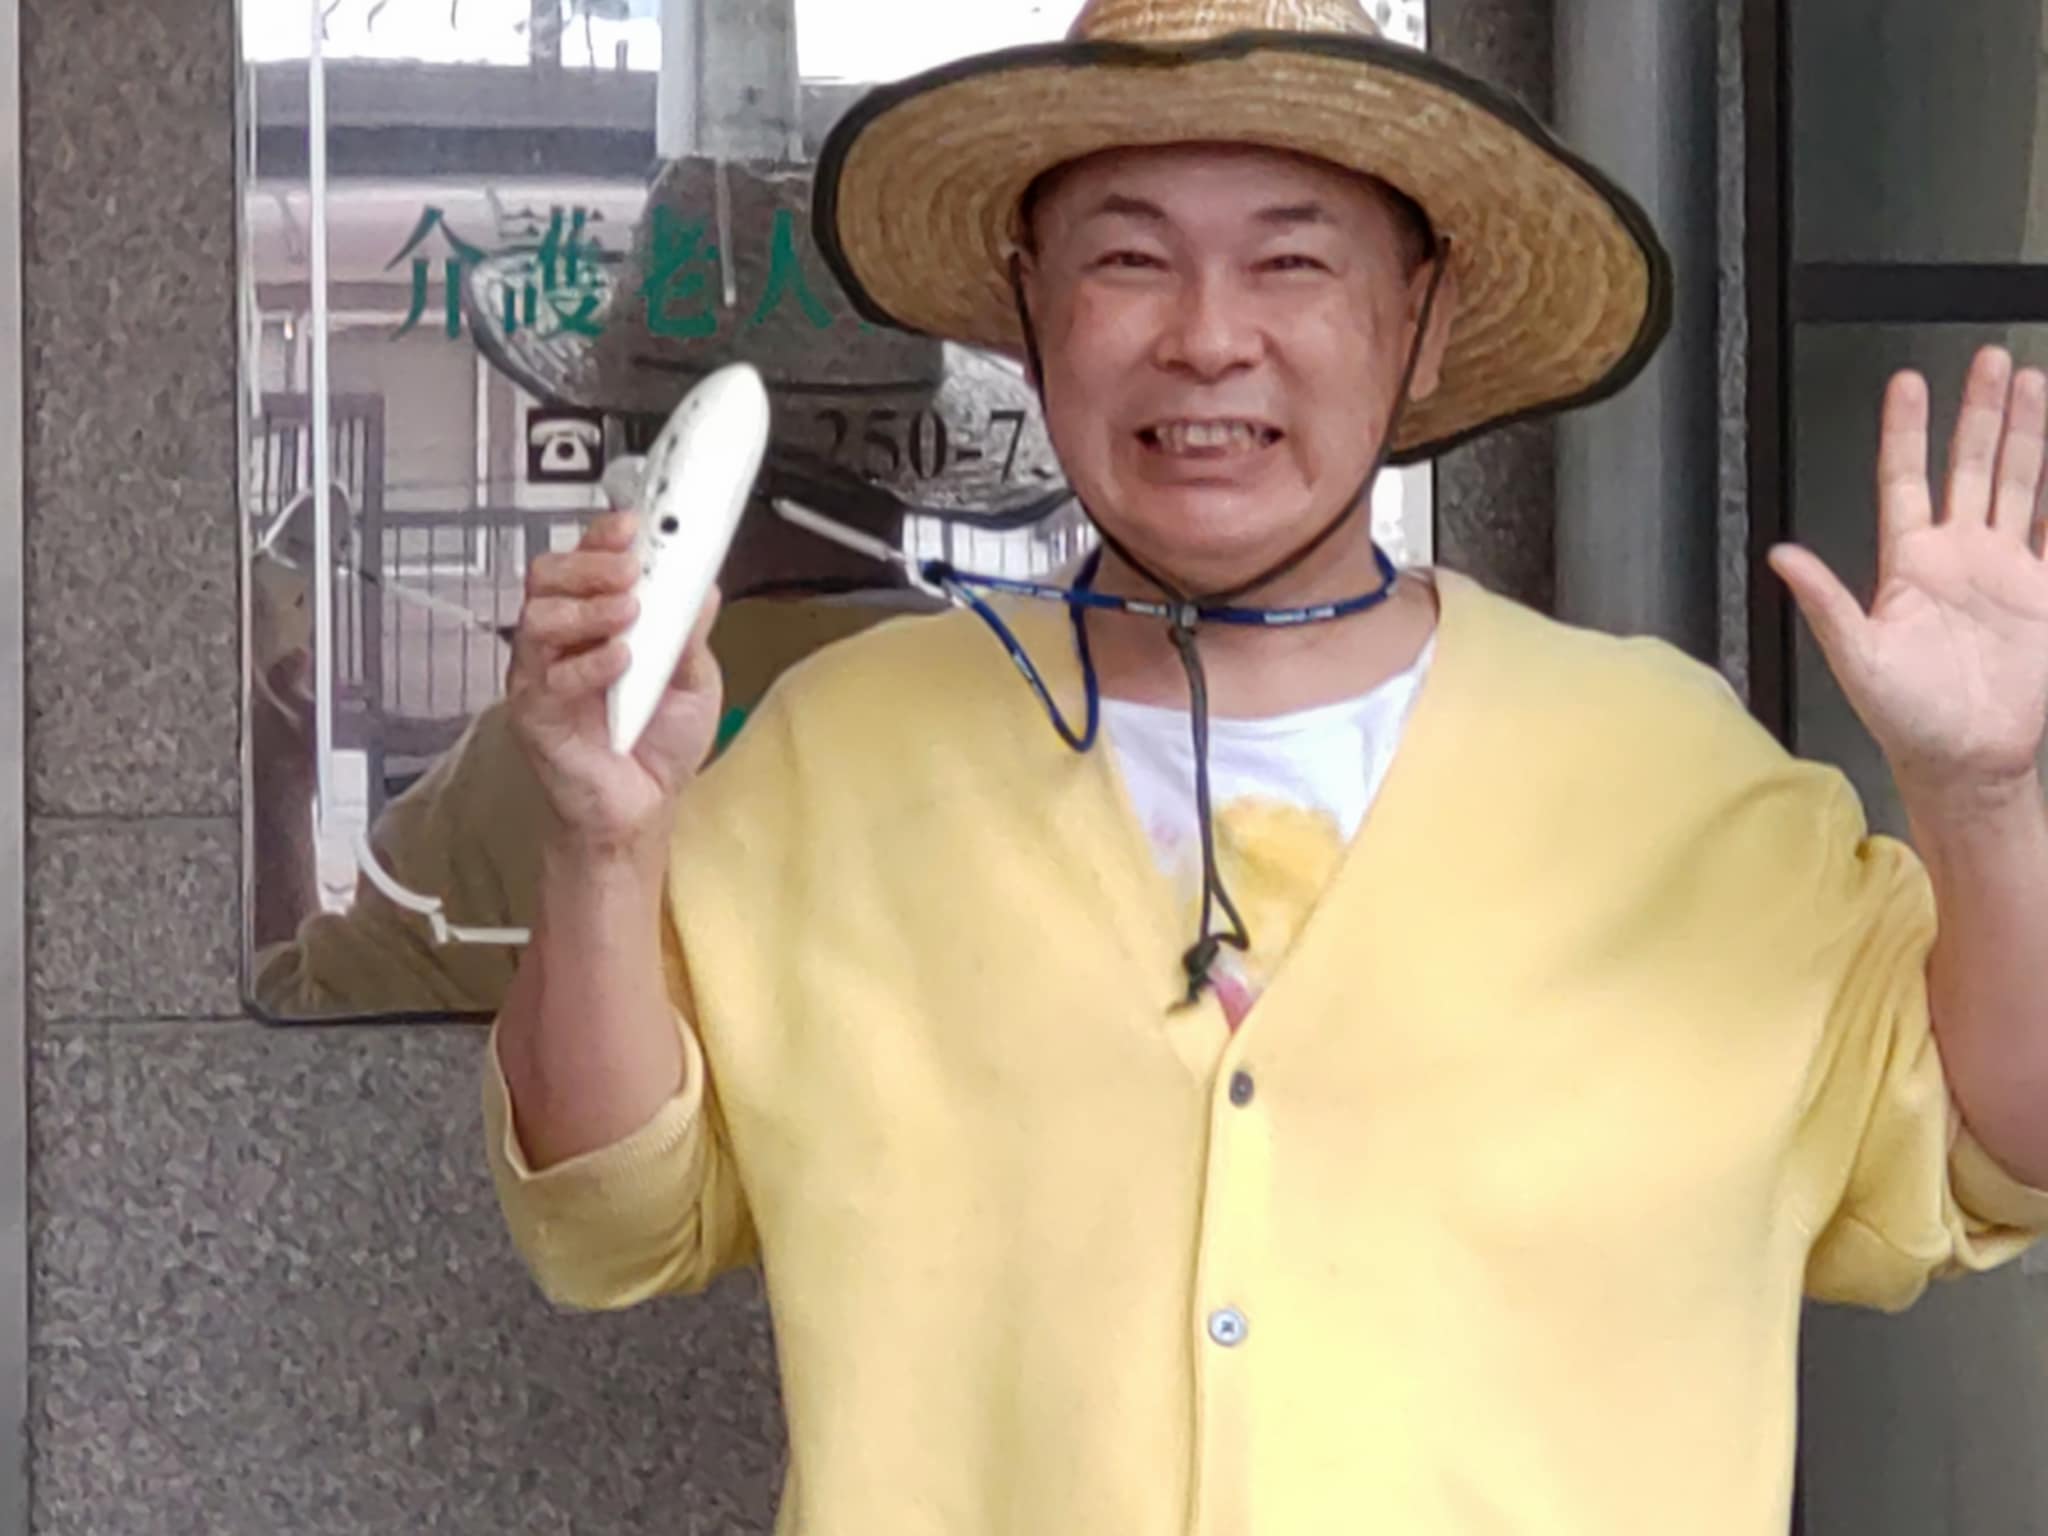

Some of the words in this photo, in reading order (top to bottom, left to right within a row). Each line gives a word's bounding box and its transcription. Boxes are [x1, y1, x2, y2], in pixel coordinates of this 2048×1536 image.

[383, 205, 874, 342] 介護老人
[815, 408, 1055, 483] 250-7
